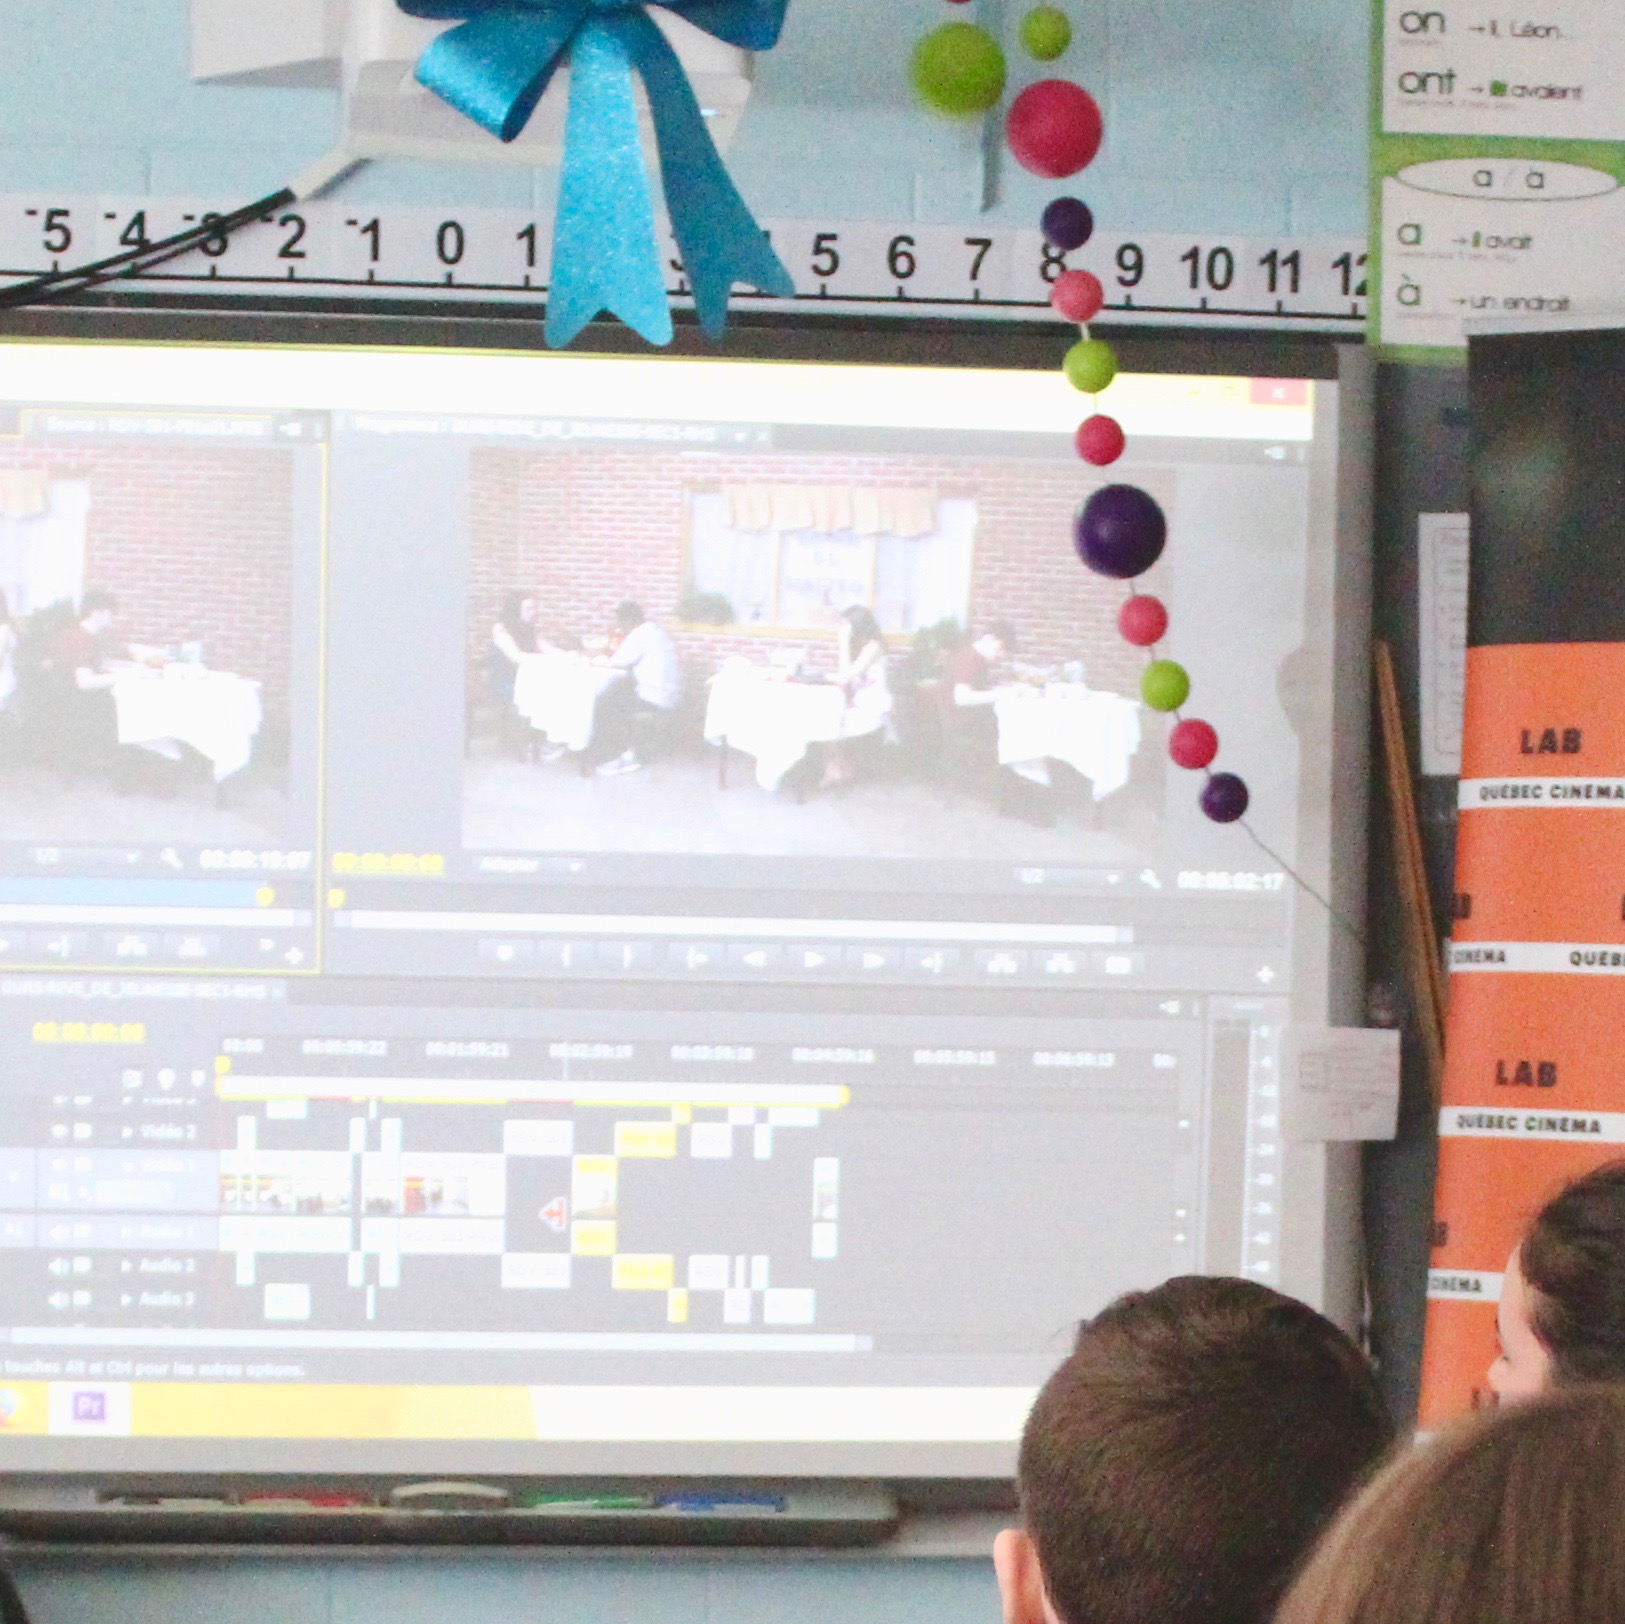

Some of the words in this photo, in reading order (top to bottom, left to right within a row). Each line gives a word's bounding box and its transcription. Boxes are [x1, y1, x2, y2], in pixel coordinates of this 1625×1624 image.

[1399, 11, 1445, 34] on
[1398, 68, 1456, 95] ont
[1473, 169, 1493, 188] a
[1397, 222, 1422, 247] a
[436, 220, 465, 266] 0
[516, 222, 538, 268] 1
[812, 233, 839, 276] 5
[888, 235, 916, 279] 6
[964, 237, 993, 281] 7
[1039, 242, 1068, 284] 8
[1115, 242, 1144, 287] 9
[1180, 246, 1234, 292] 10
[1259, 249, 1301, 294] 11
[1396, 272, 1421, 308] à
[1520, 728, 1582, 755] LAB
[1494, 1060, 1557, 1088] LAB
